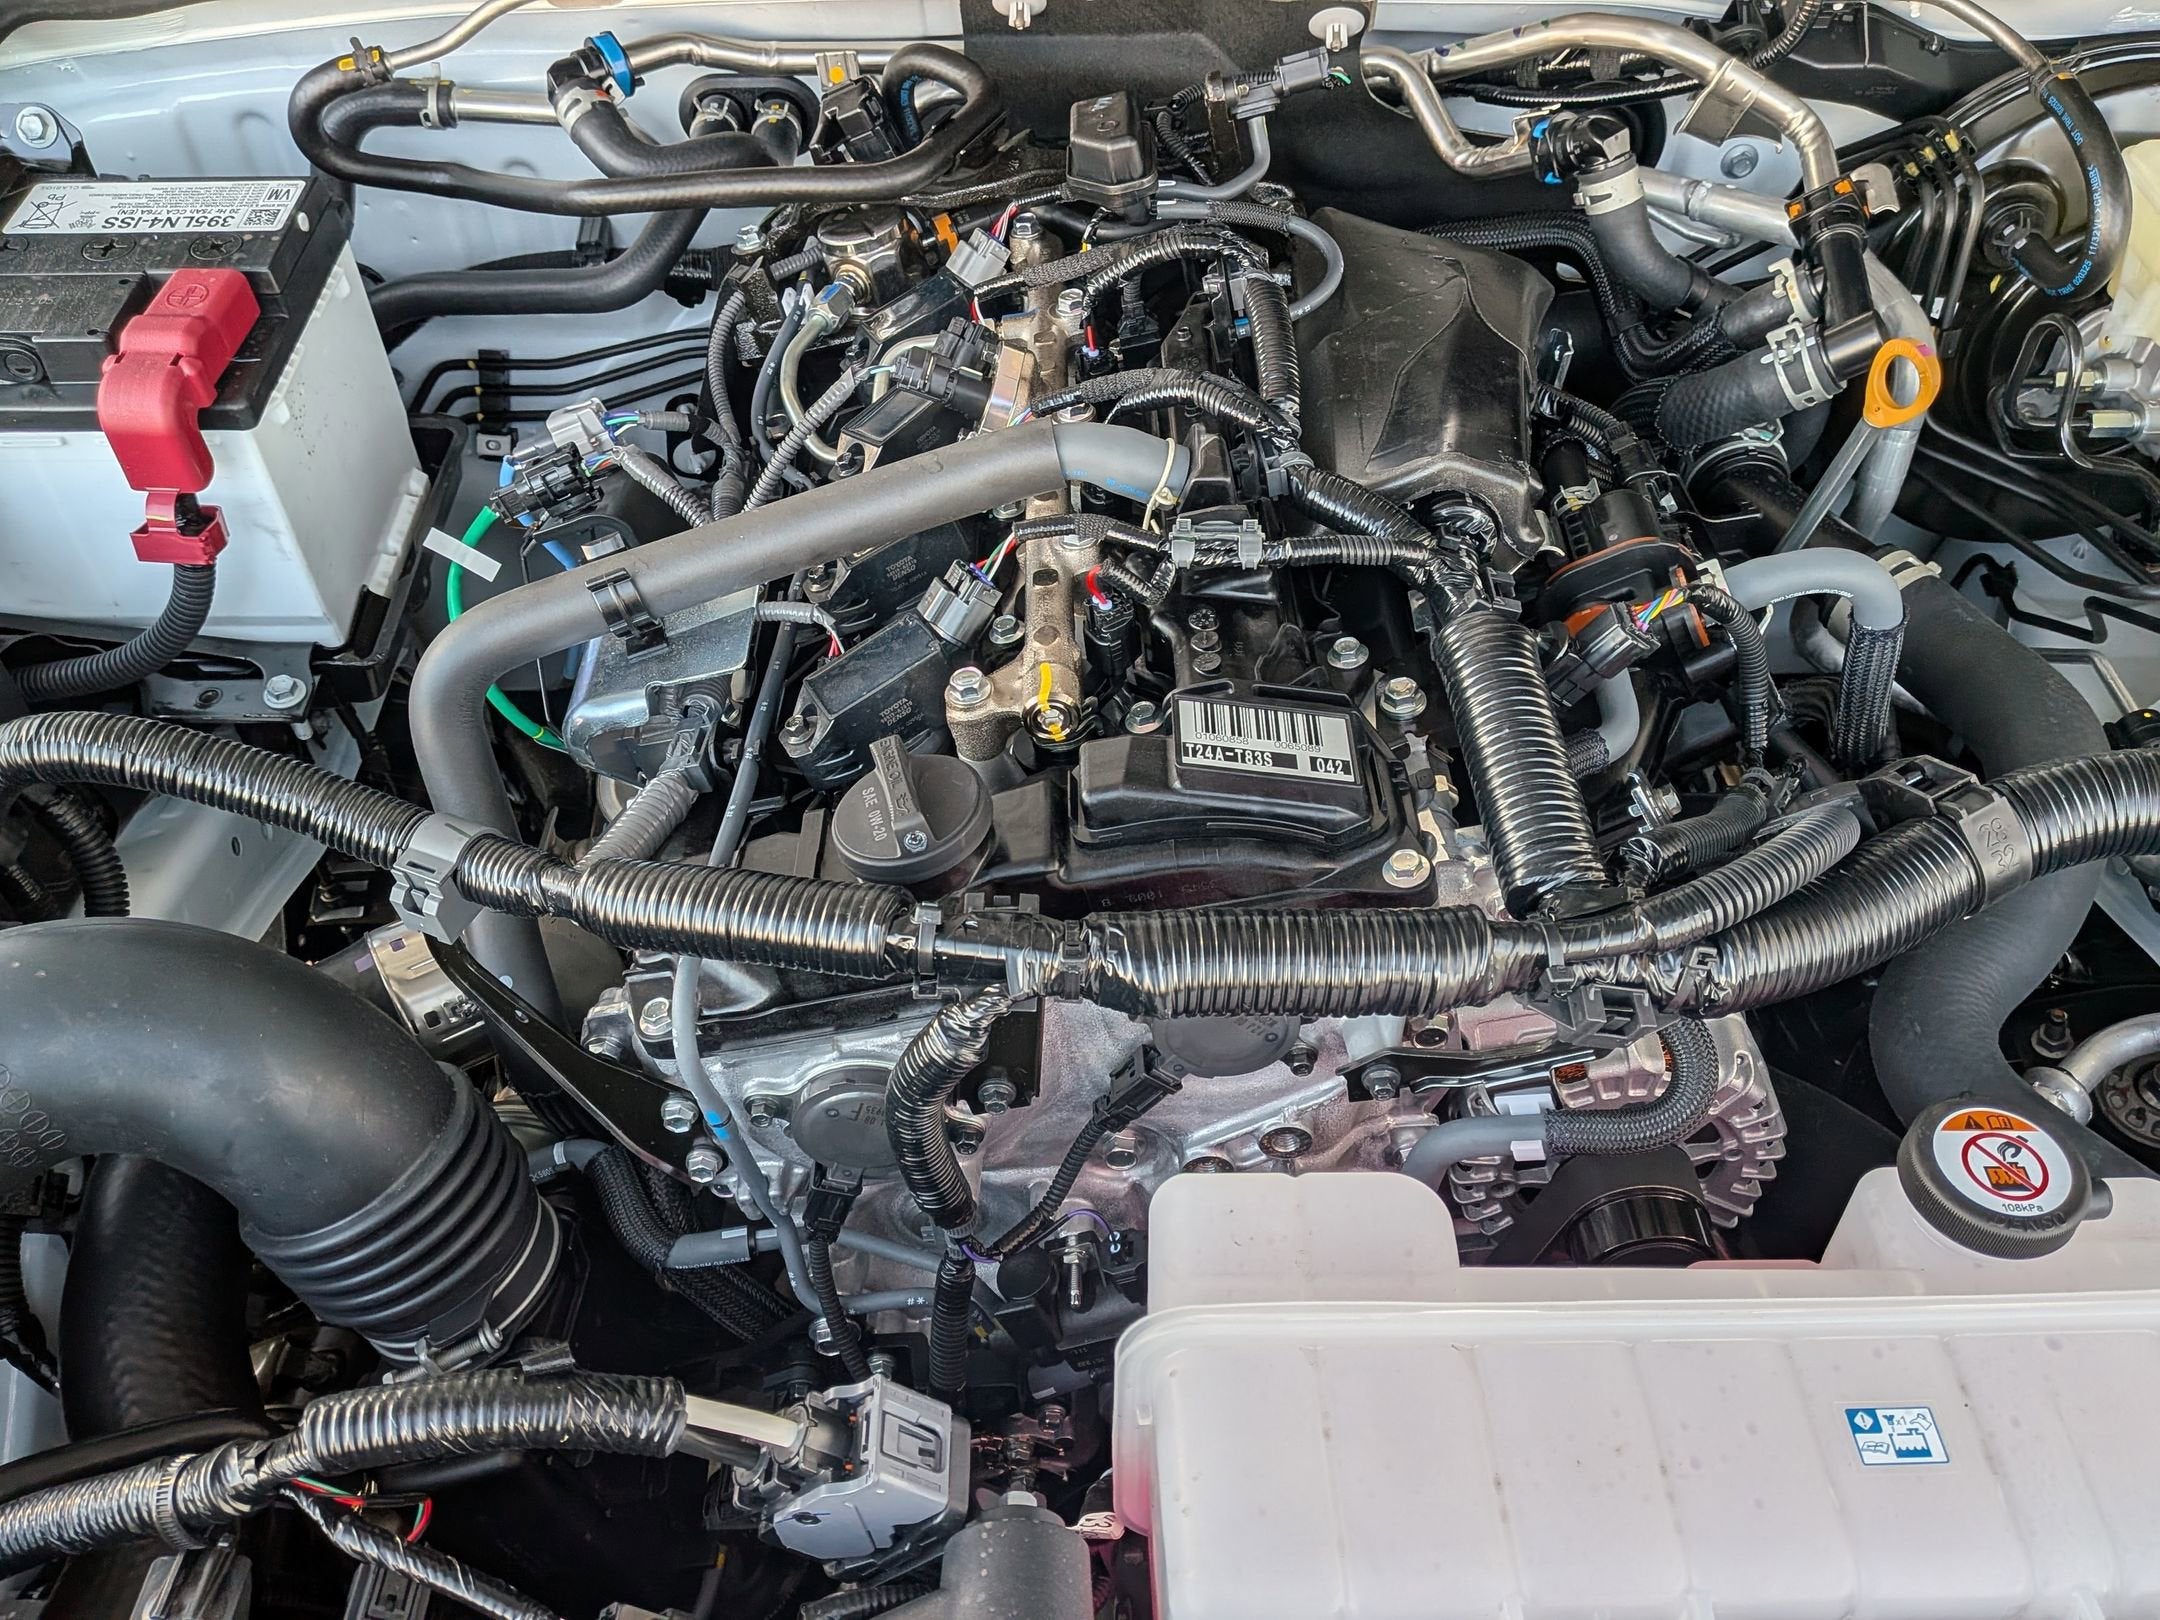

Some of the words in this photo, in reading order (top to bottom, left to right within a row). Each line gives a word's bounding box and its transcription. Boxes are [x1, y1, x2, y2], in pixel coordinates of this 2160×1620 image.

[2070, 129, 2084, 146] DOT
[266, 189, 291, 201] VM
[101, 215, 236, 229] 395LN4-ISS
[885, 555, 914, 572] TOYOTA
[892, 565, 916, 581] DENSO
[879, 698, 909, 717] TOYOTA
[887, 707, 912, 726] DENSO
[1194, 732, 1249, 746] 01060858
[1274, 741, 1322, 753] 0065089
[879, 738, 900, 773] ENGINE
[1185, 743, 1273, 767] T24A-T83S
[1316, 758, 1345, 775] 042
[887, 770, 904, 790] OIL
[861, 786, 878, 808] SAE
[868, 809, 888, 842] 0W-20
[2001, 1203, 2044, 1213] 108kPa
[1991, 1211, 2067, 1232] DENSO
